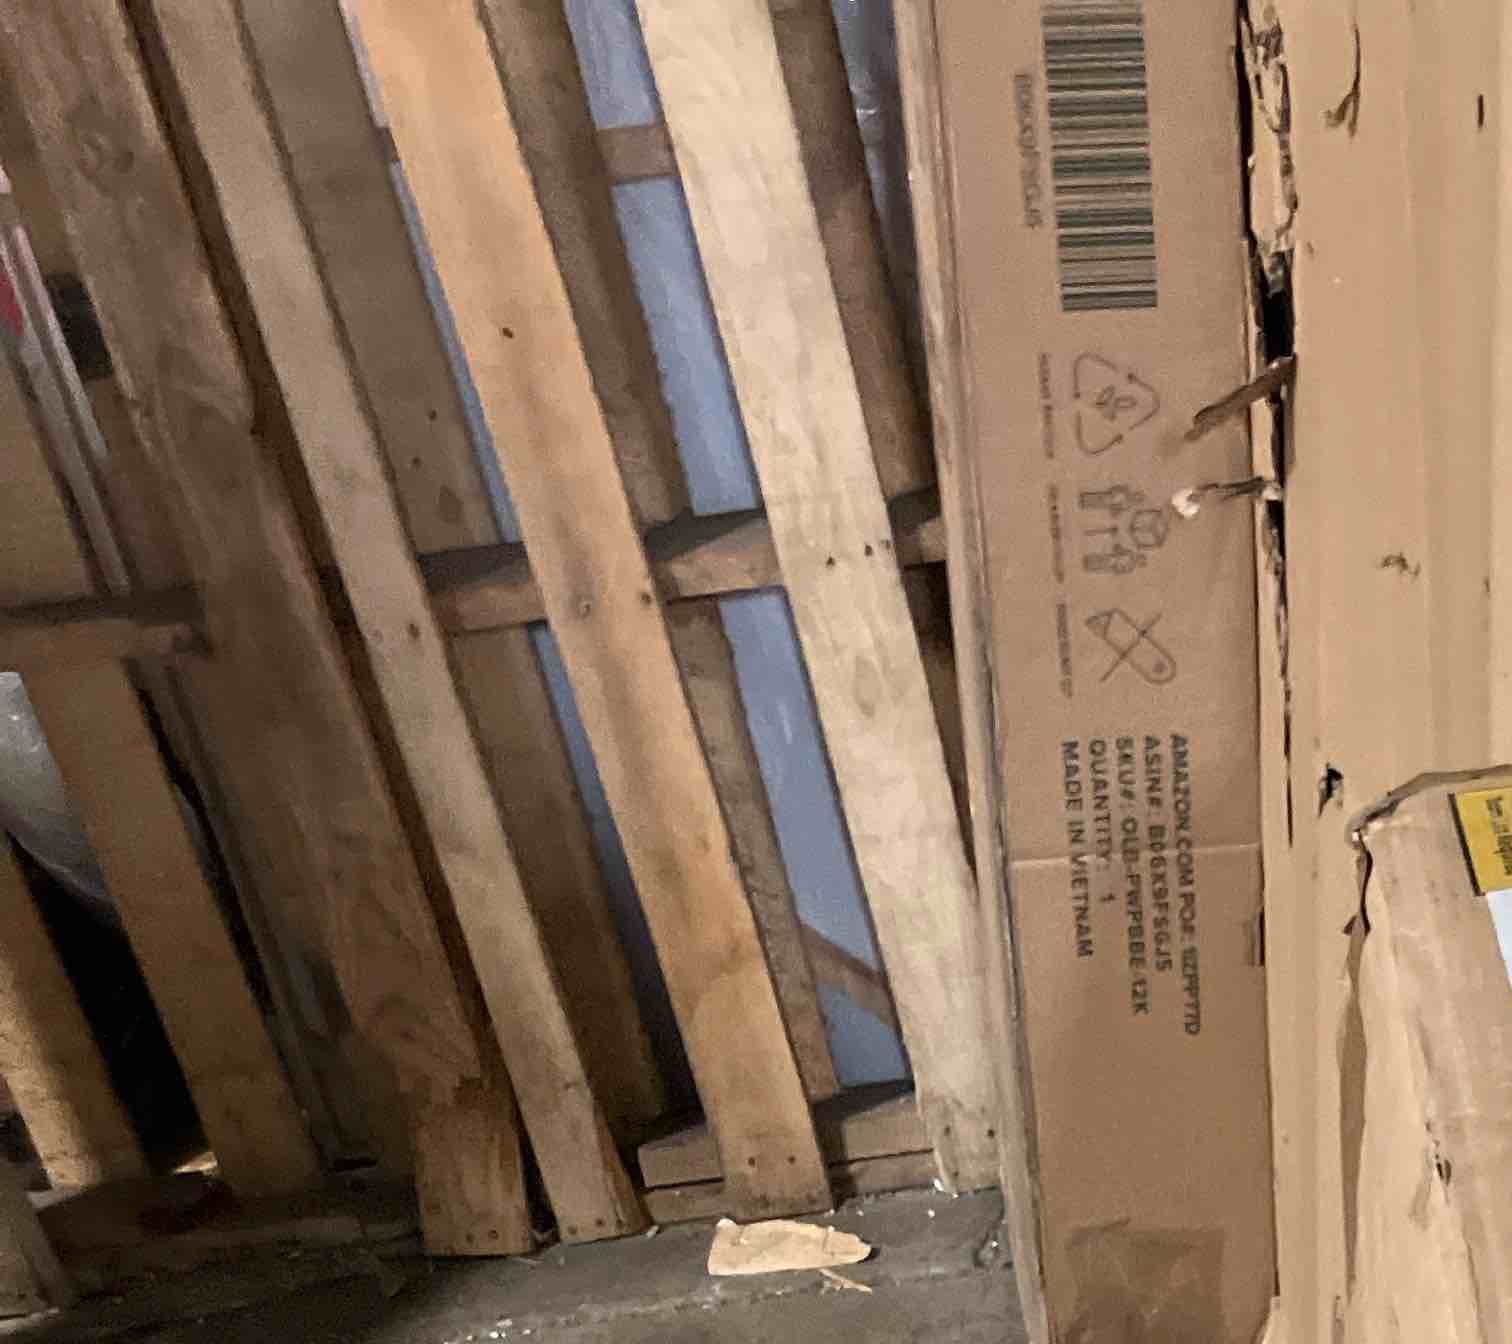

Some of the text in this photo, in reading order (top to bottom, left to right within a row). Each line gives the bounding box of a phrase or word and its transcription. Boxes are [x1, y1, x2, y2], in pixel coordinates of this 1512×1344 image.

[1062, 741, 1094, 956] MADE IN VIETNAM
